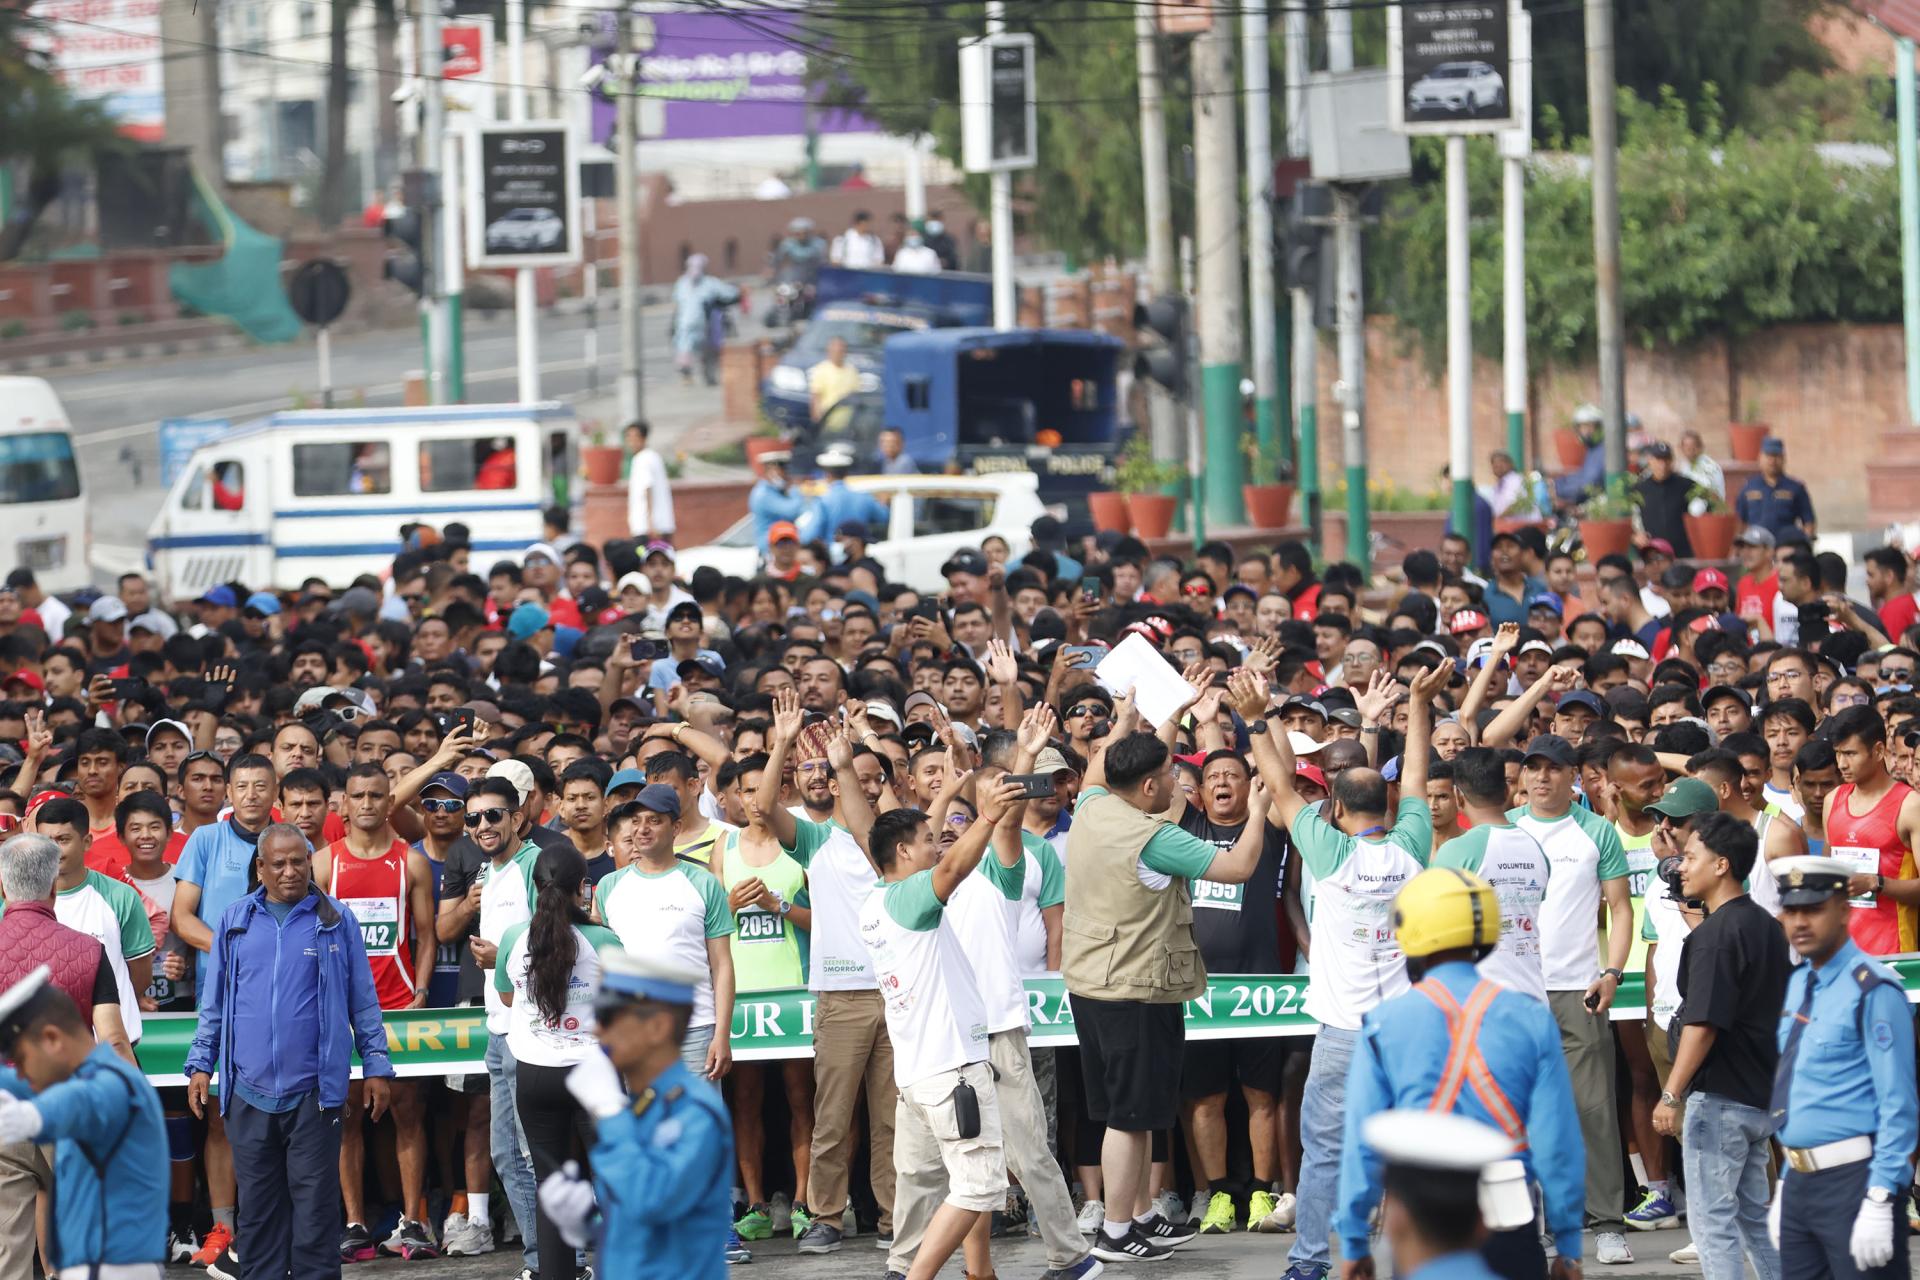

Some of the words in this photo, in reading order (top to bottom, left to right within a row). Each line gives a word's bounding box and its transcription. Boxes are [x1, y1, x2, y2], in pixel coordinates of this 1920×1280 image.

[974, 456, 1030, 473] NEPAL
[1047, 455, 1104, 474] POLICE
[1498, 862, 1535, 870] VOLUNTEER
[1357, 873, 1406, 882] VOLUNTEER
[740, 914, 783, 937] 2051
